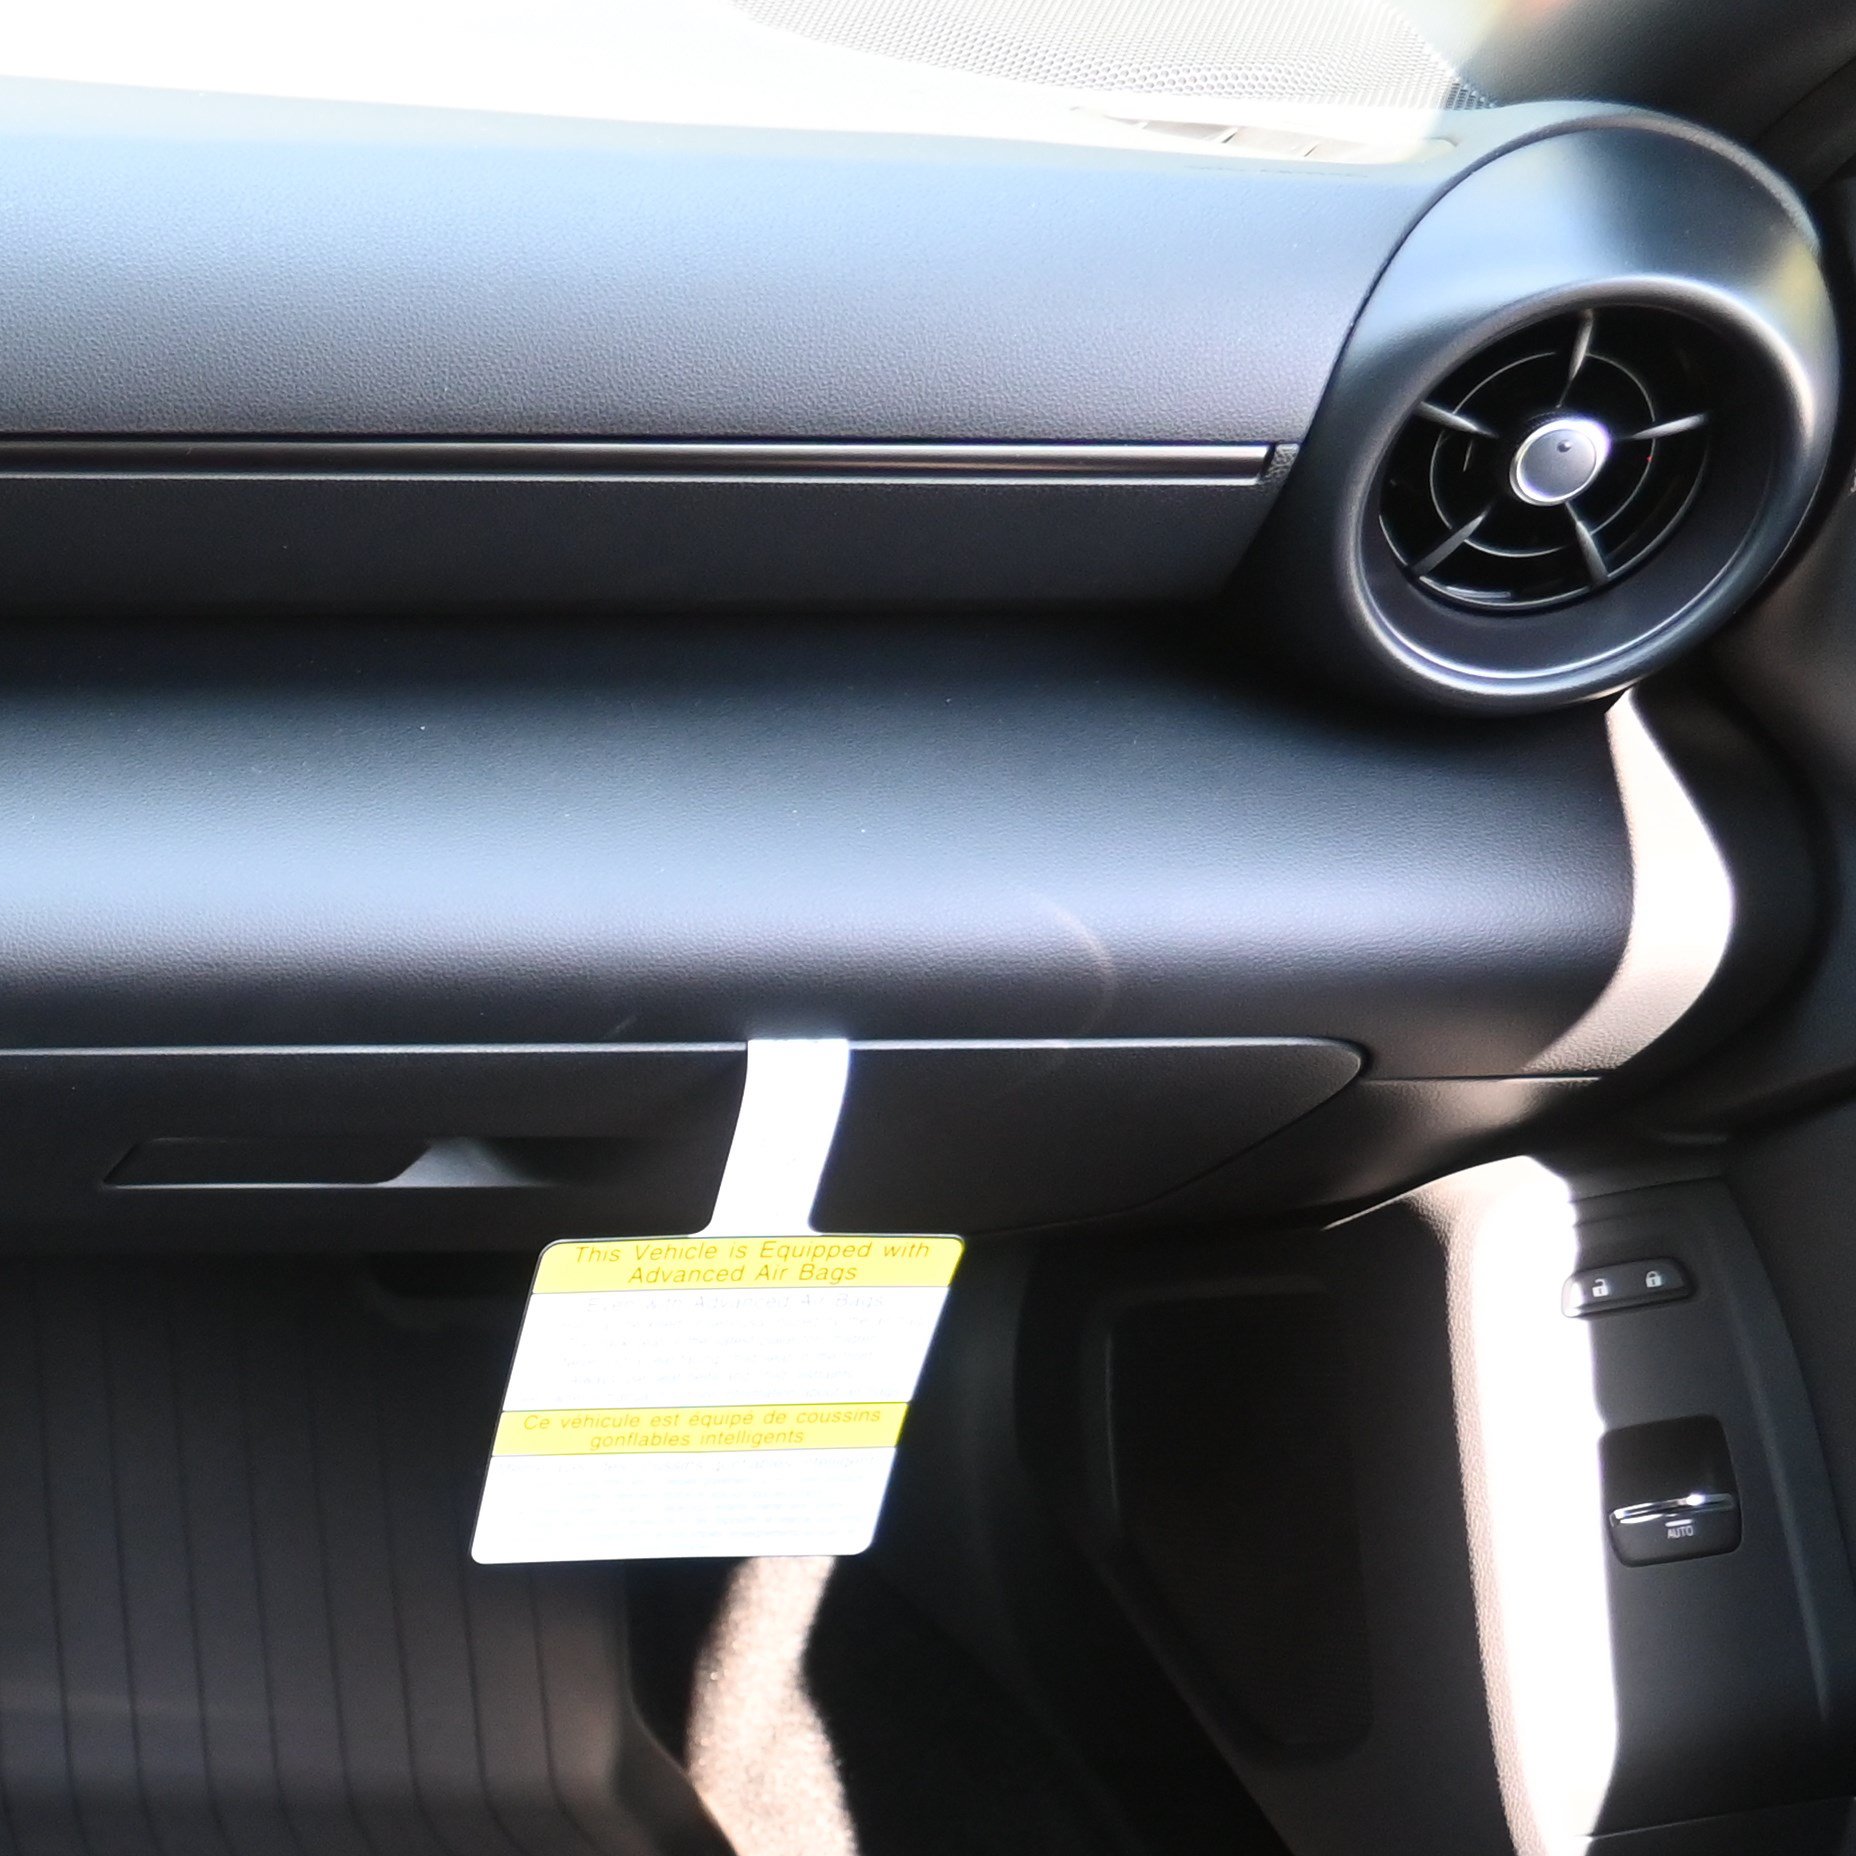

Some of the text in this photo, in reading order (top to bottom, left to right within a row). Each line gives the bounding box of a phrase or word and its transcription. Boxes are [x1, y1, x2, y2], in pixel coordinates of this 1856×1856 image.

[575, 1239, 930, 1264] This Vehicle is Equipped with
[627, 1262, 858, 1286] Advanced Air Bags
[523, 1413, 551, 1431] Ce
[649, 1413, 682, 1428] est
[763, 1410, 788, 1425] de
[795, 1409, 882, 1424] coussins
[589, 1429, 806, 1451] gonflables intelligents
[1666, 1525, 1694, 1539] AUTO
